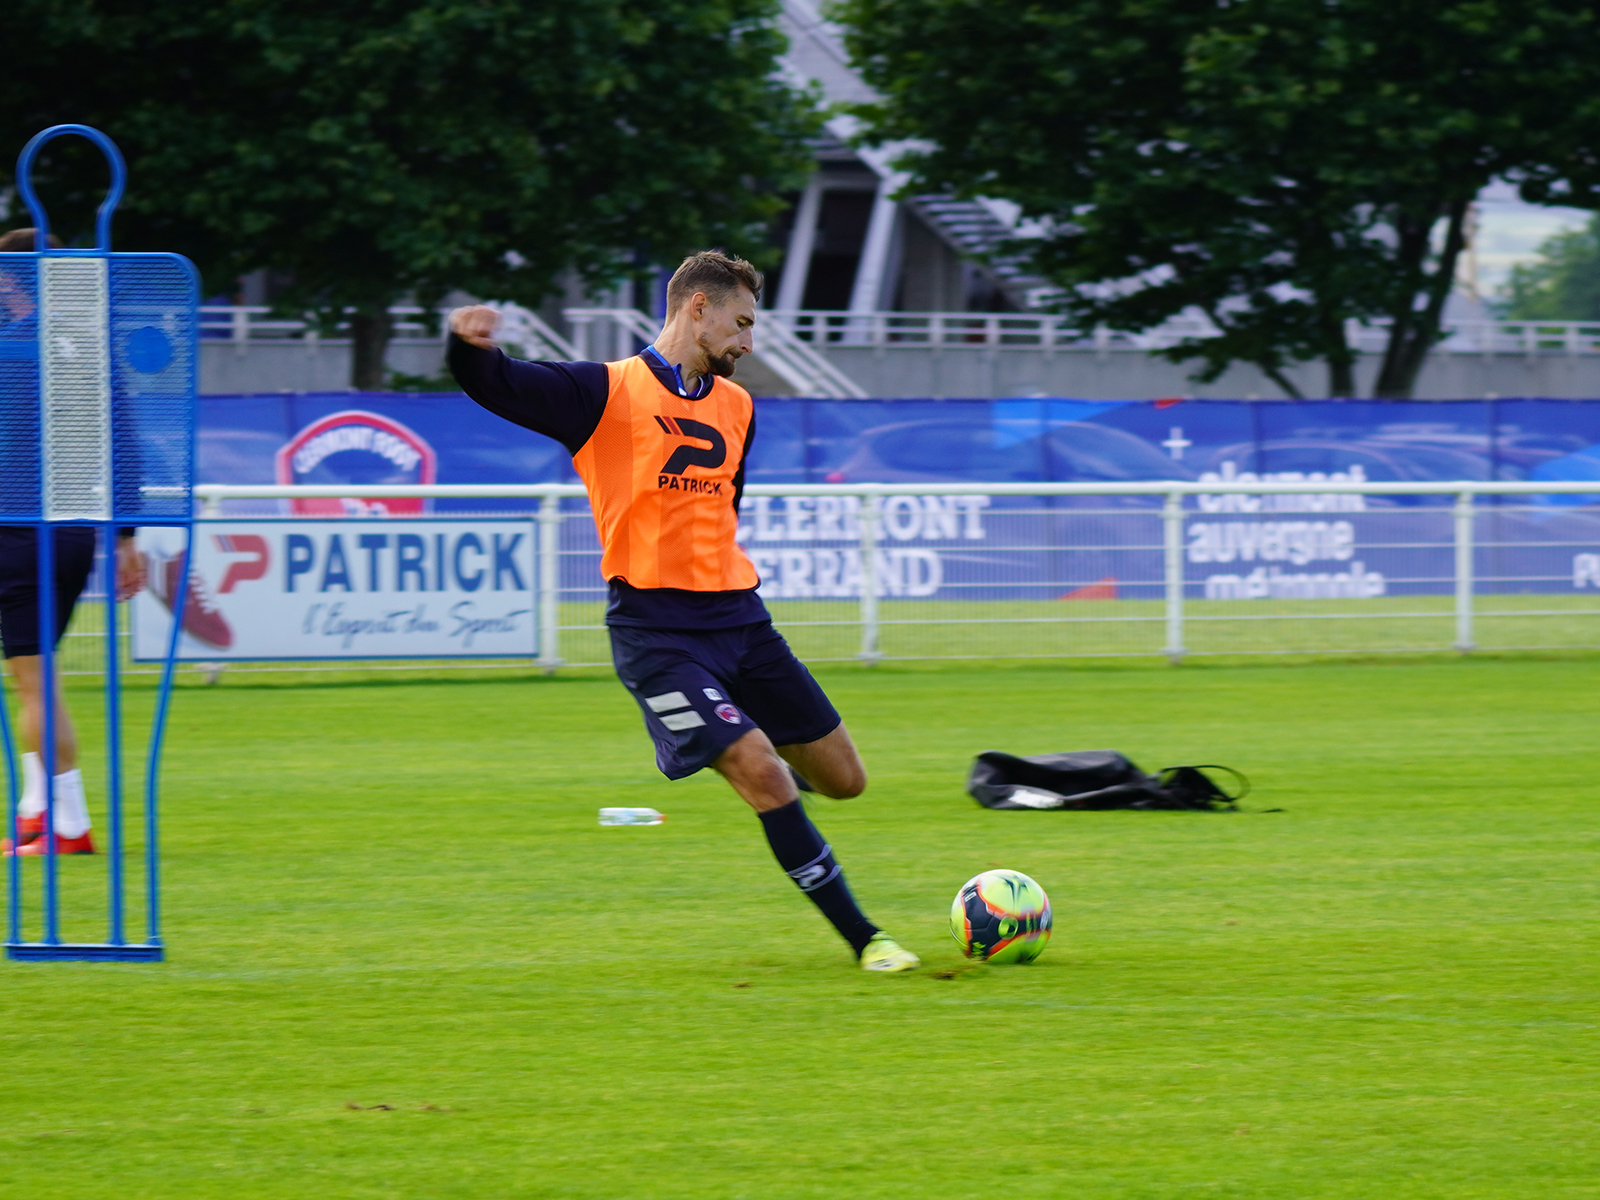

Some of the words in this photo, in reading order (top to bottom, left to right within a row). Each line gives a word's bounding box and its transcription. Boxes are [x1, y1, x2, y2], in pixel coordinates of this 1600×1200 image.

[658, 475, 723, 496] PATRICK
[283, 532, 528, 593] PATRICK
[751, 550, 944, 598] ERRAND
